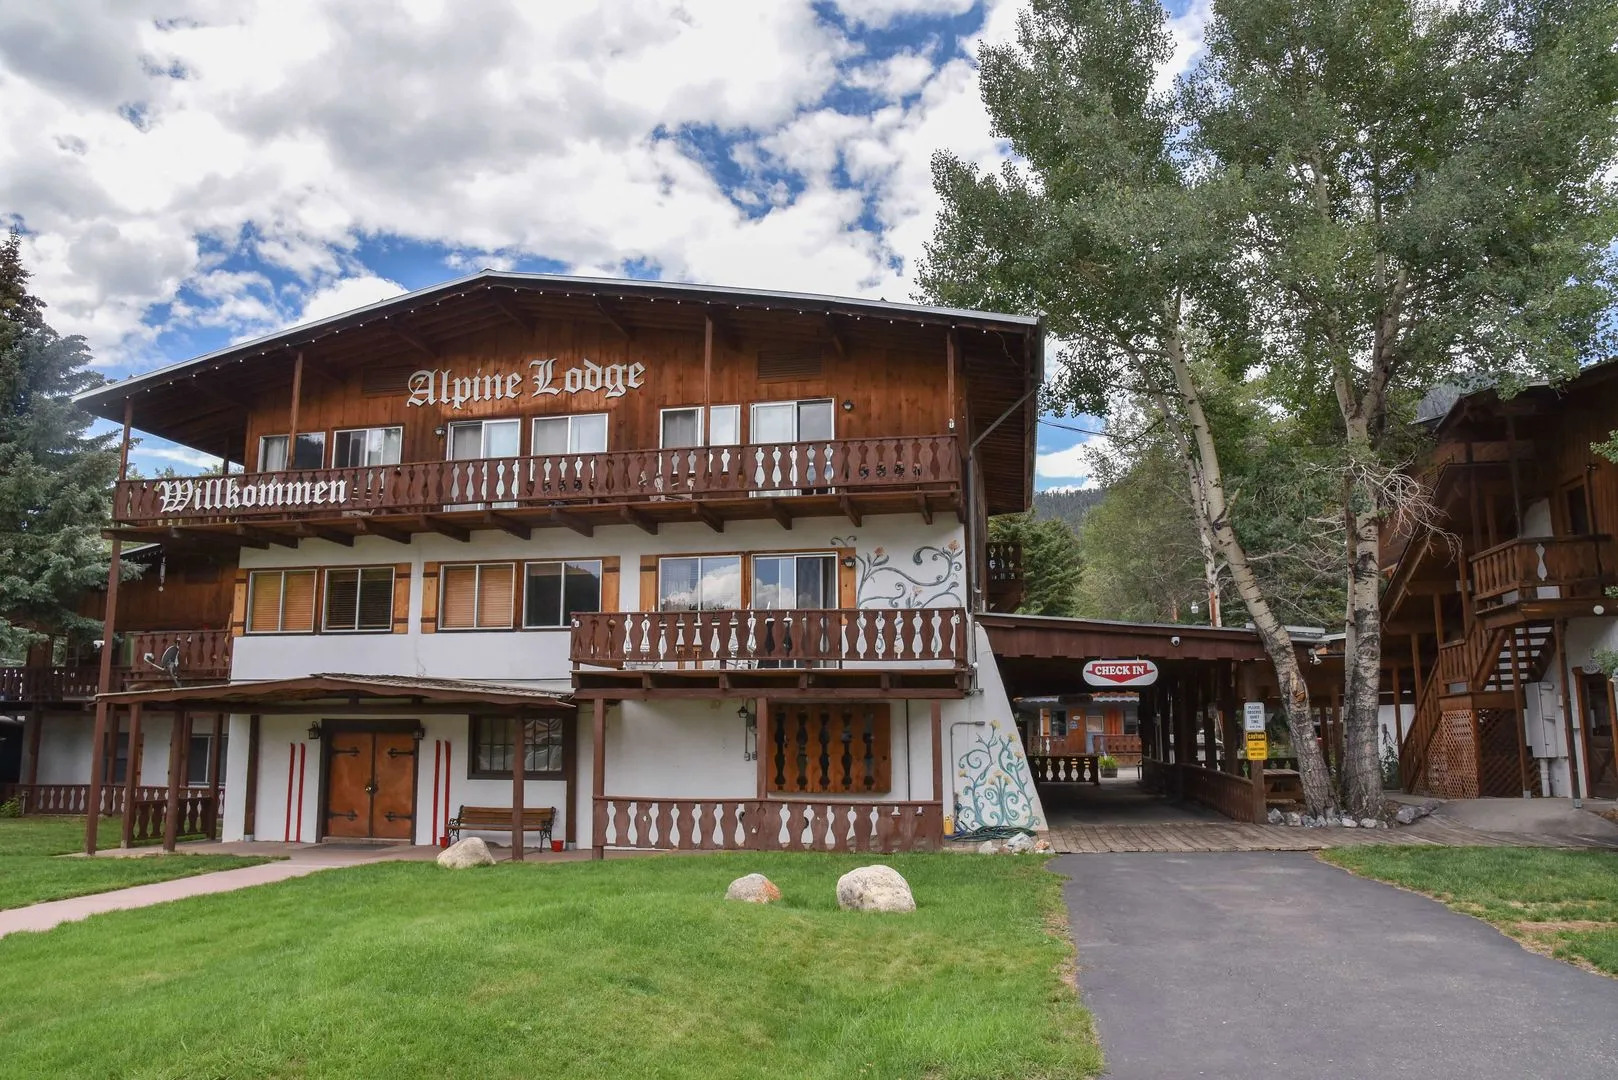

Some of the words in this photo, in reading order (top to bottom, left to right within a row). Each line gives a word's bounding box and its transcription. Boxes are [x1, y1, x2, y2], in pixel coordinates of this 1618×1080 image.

[406, 368, 522, 410] Alpine
[528, 357, 646, 398] Lodge
[159, 477, 348, 513] Willkommen
[1095, 666, 1130, 675] CHECK
[1132, 666, 1145, 675] IN
